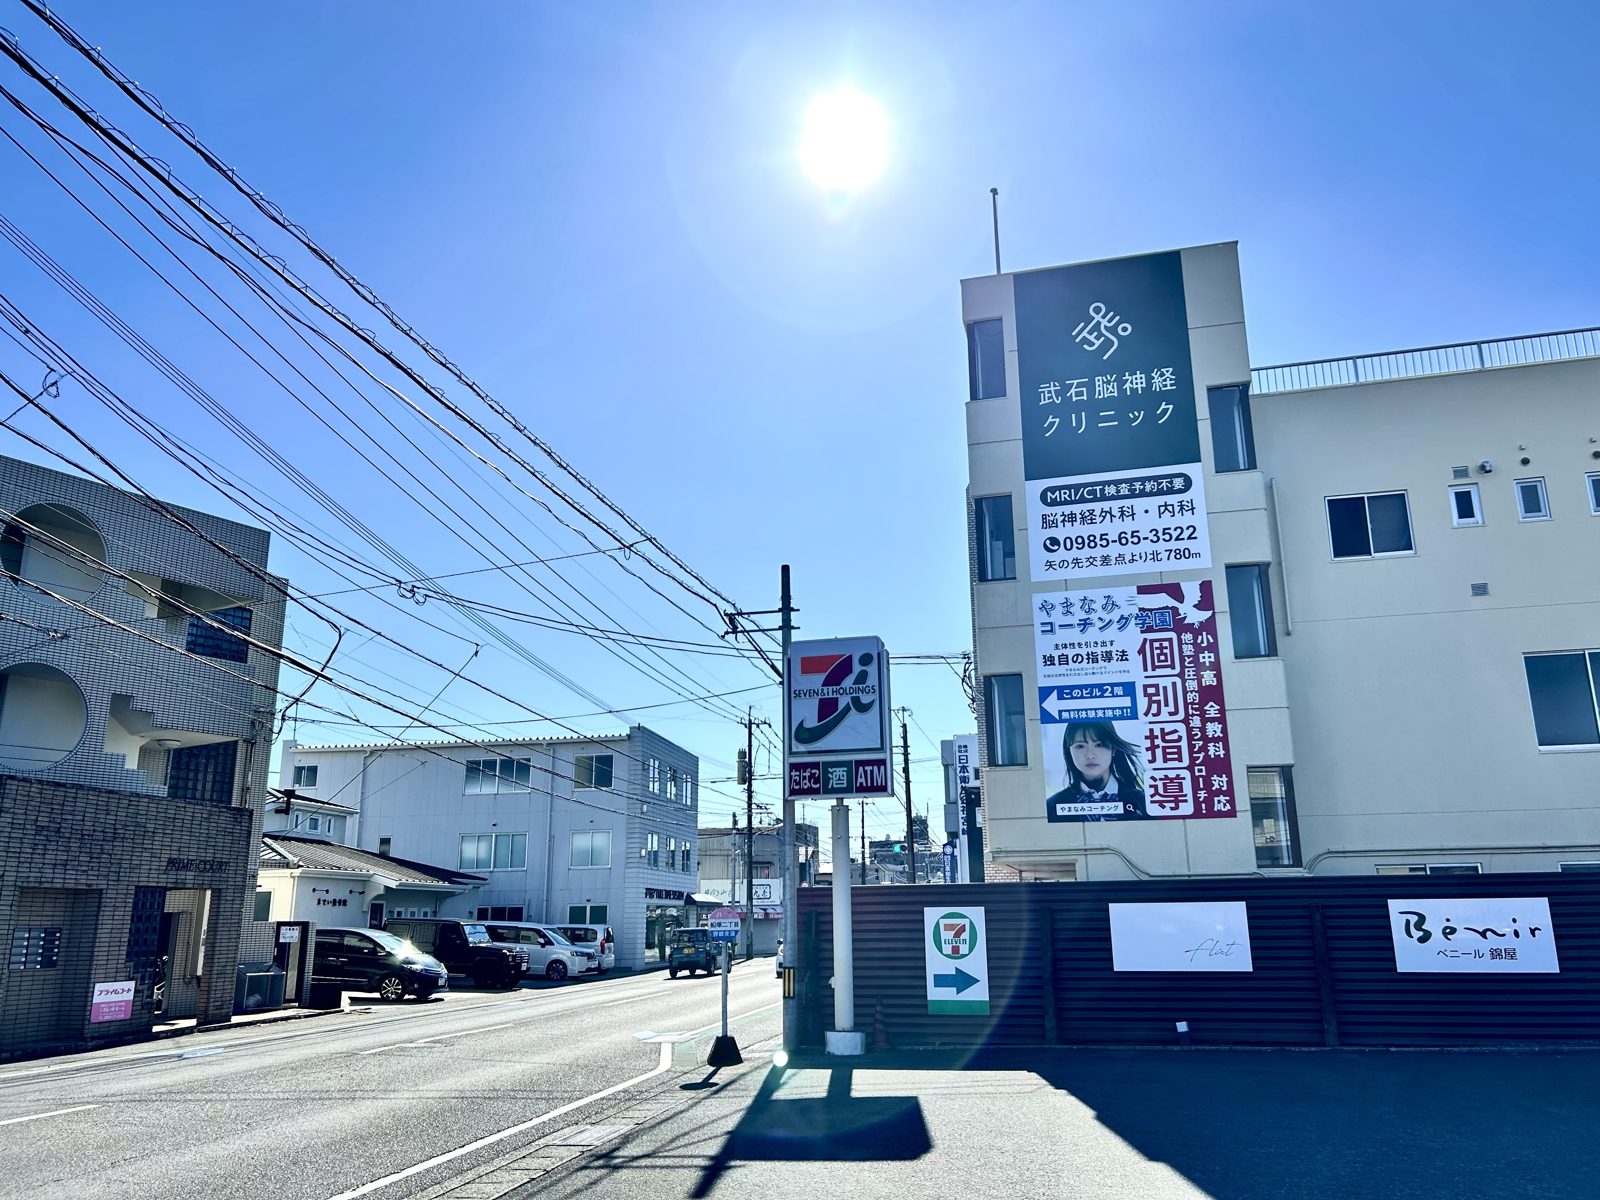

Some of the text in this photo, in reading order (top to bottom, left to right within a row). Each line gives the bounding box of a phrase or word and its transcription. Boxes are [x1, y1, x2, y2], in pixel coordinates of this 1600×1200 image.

[1038, 367, 1177, 405] 武石脳神経
[1043, 401, 1174, 437] クリニック
[1047, 477, 1186, 503] MRI/CT検査予約不要
[1041, 499, 1196, 529] 脳神経外科・内科
[1063, 524, 1198, 551] 0985-65-3522
[1039, 594, 1120, 617] やまなみ
[1040, 609, 1173, 635] コーチング学園
[1053, 639, 1116, 651] 主体性を引き出す
[1042, 649, 1129, 667] 独自の指導法
[831, 684, 876, 697] HOLDINGS
[1063, 685, 1124, 698] このビル2階
[1137, 637, 1188, 811] 個別指導
[1197, 631, 1231, 811] 小中高 全教科 対応
[790, 767, 820, 790] たばこ
[827, 767, 848, 789] 酒
[856, 765, 885, 787] ATM
[1060, 805, 1119, 813] やまなみコーチング
[1437, 948, 1518, 960] ベニール 錦屋
